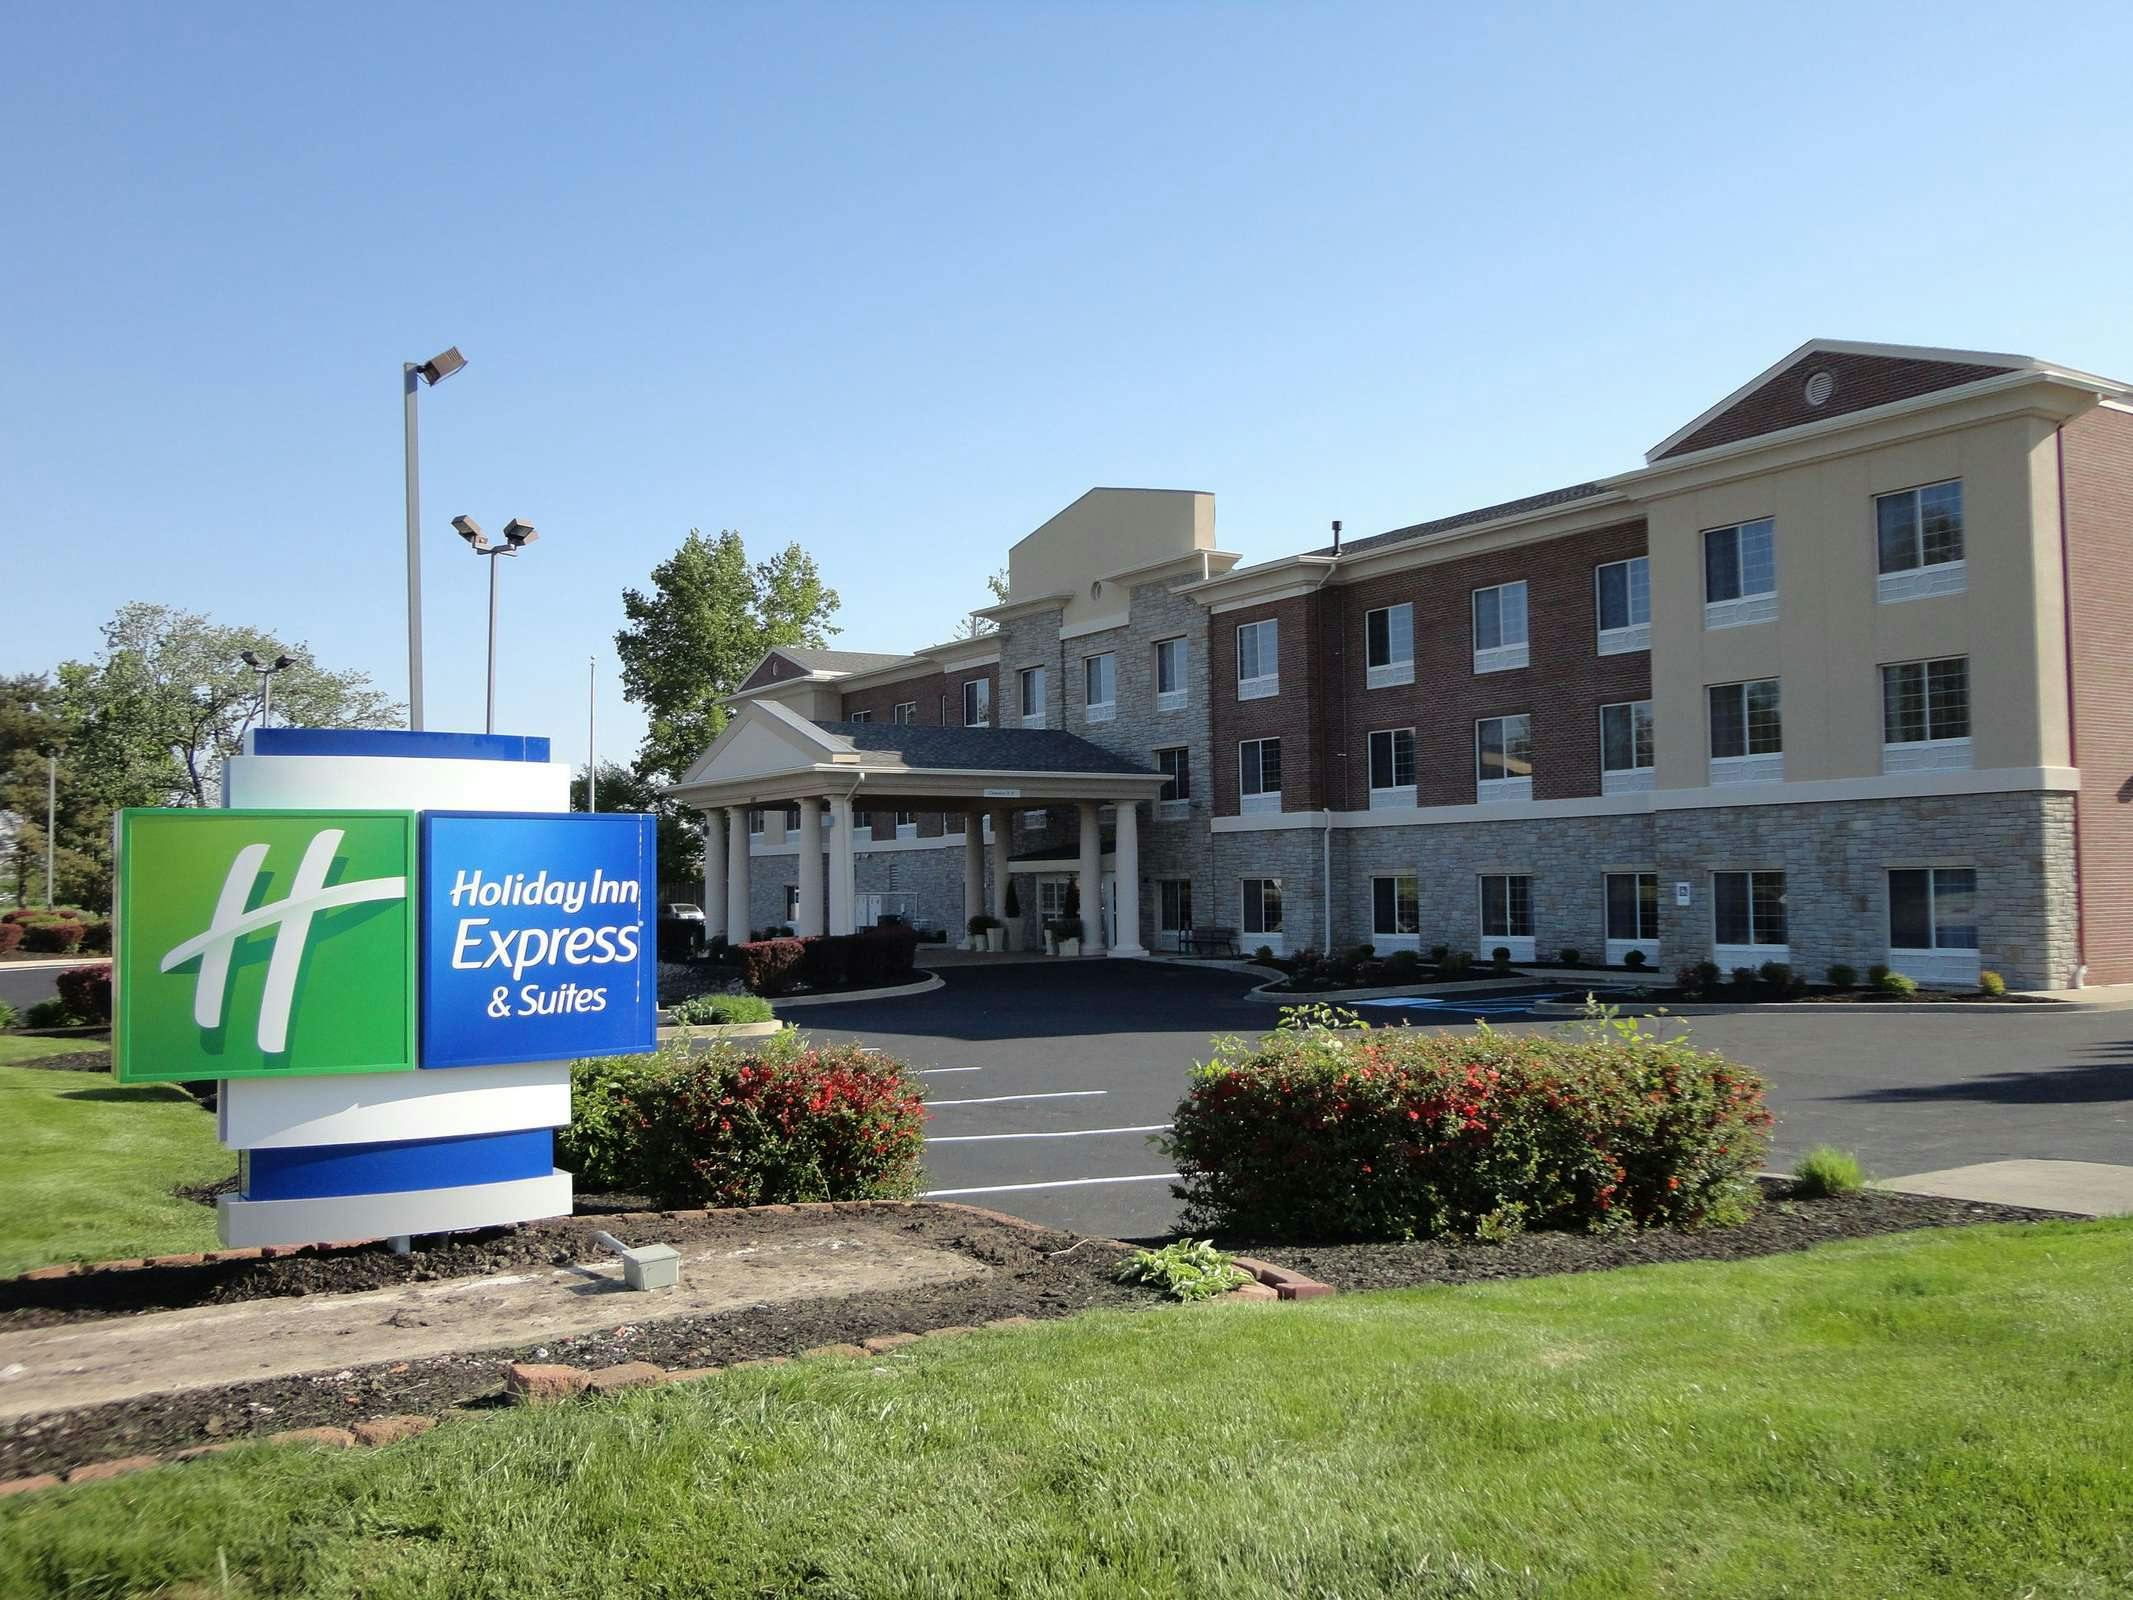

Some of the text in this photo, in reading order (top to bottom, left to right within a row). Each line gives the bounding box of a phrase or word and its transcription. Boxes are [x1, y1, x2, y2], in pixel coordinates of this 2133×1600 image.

[450, 869, 639, 913] Holiday Inn
[452, 918, 639, 981] Express
[487, 983, 607, 1018] & Suites
